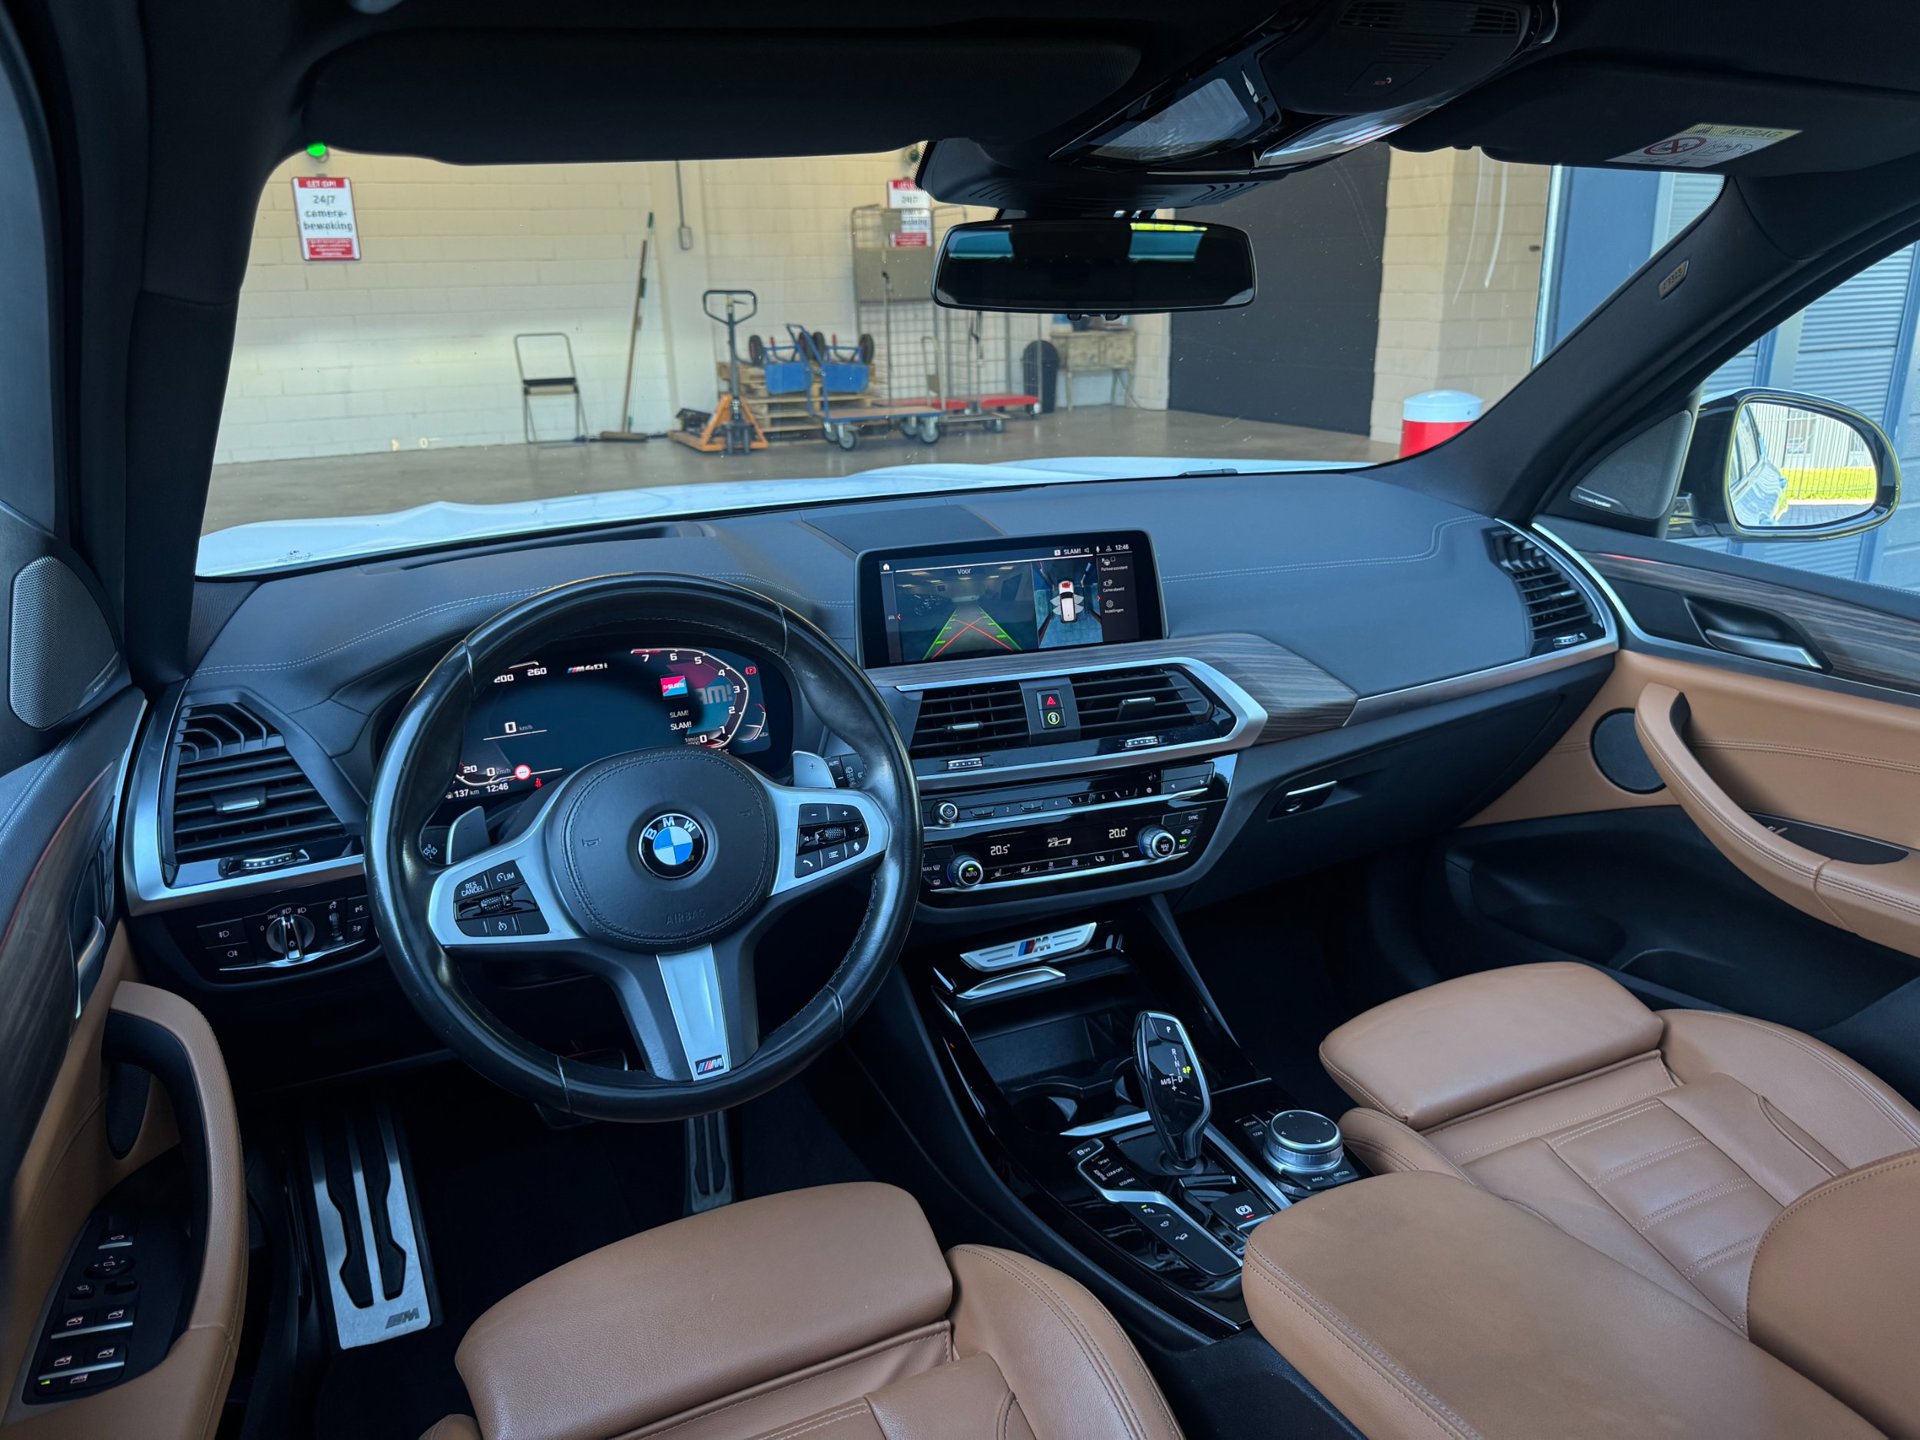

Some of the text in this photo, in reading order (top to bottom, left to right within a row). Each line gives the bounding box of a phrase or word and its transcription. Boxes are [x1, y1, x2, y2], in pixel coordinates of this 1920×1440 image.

[312, 195, 336, 206] 24/7
[304, 209, 347, 218] camera-
[303, 221, 353, 232] bewaking
[641, 654, 650, 662] 7
[669, 652, 678, 661] 6
[694, 656, 702, 664] 5
[527, 667, 547, 676] 260
[717, 669, 726, 677] 4
[733, 685, 740, 693] 3
[669, 710, 689, 718] SLAM!
[728, 706, 736, 714] 2
[504, 721, 517, 733] 0
[670, 721, 692, 730] SLAM!
[719, 725, 726, 734] 1
[699, 734, 708, 743] 0
[463, 765, 478, 773] 20
[486, 767, 495, 776] 0
[486, 783, 509, 793] 12:46
[454, 789, 469, 798] 137
[644, 816, 696, 841] BMW
[461, 885, 485, 897] CANCEL
[1166, 1026, 1171, 1034] P
